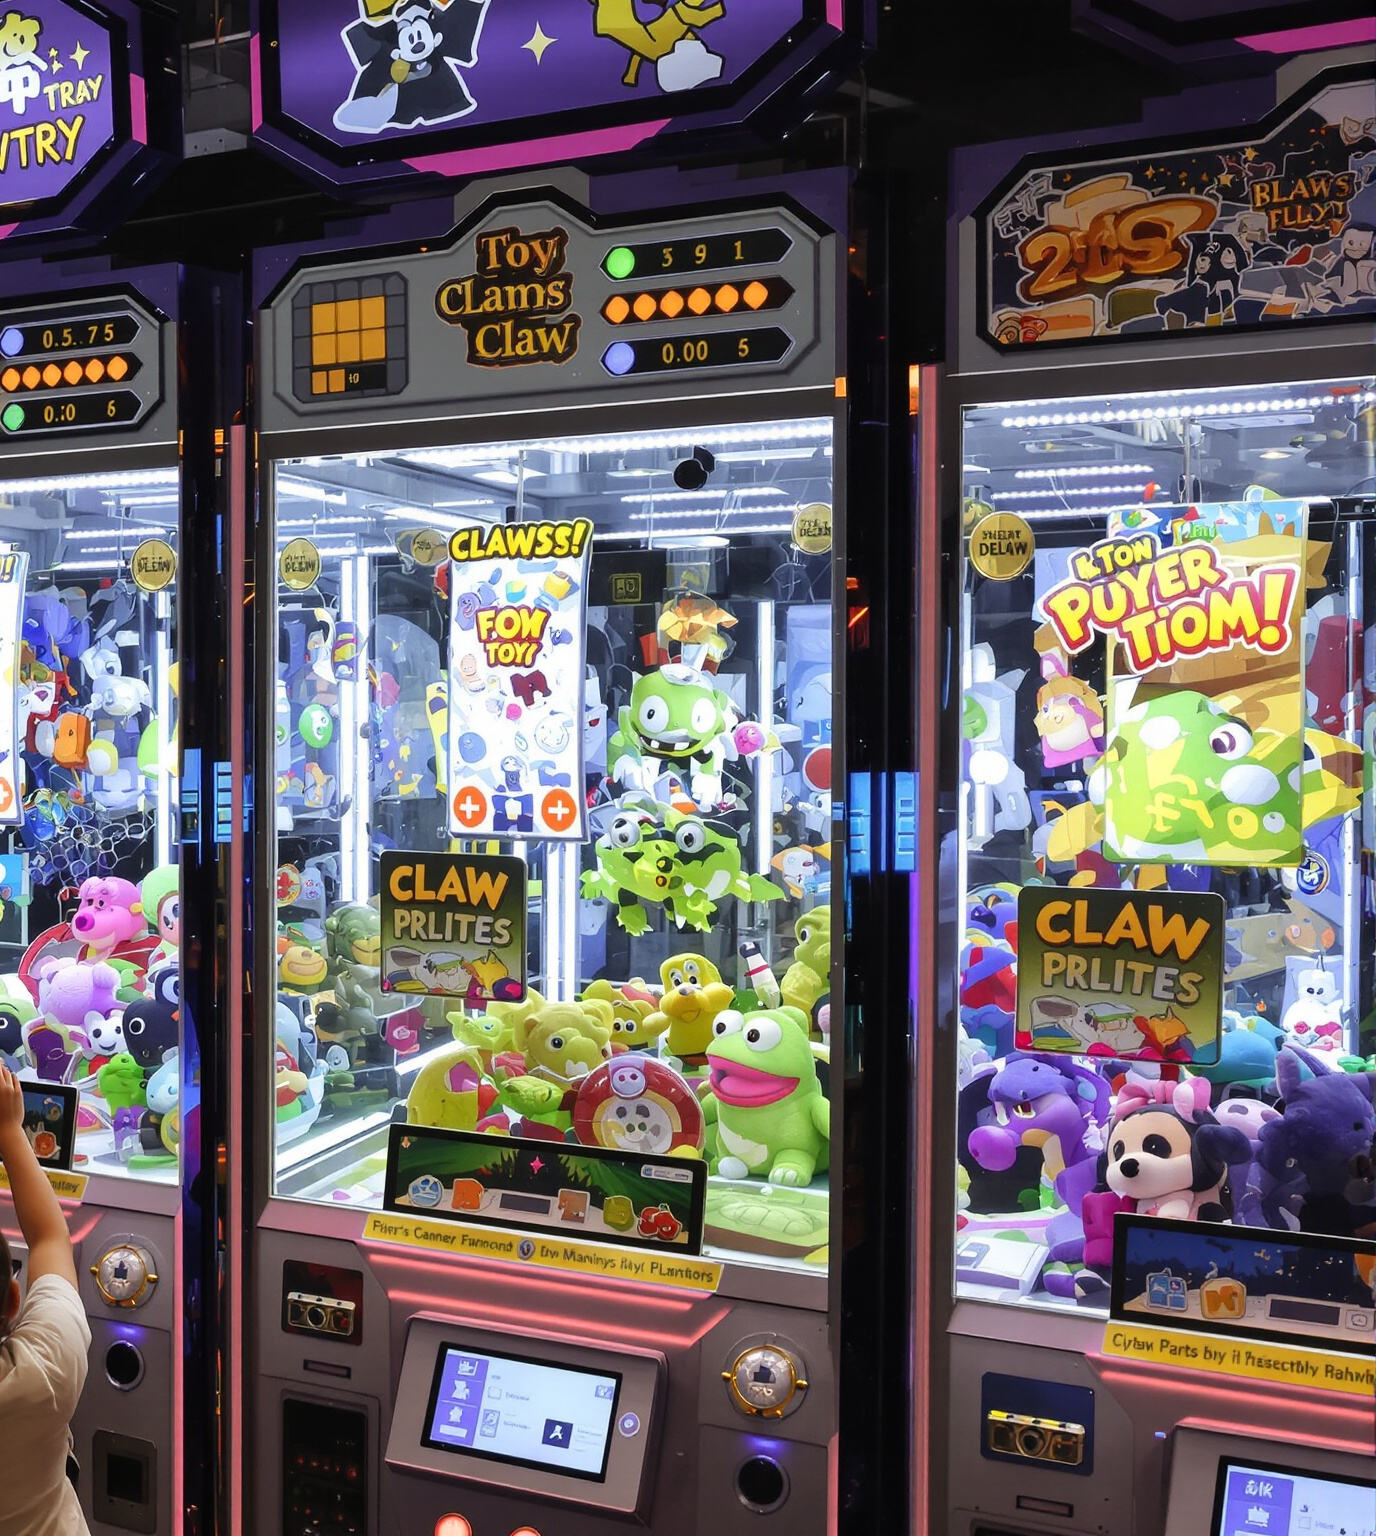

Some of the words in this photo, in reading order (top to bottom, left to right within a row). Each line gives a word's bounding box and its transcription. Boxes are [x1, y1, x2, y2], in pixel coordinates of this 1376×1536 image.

[43, 74, 103, 111] TRAY
[1252, 175, 1351, 207] BLAWS
[481, 233, 561, 276] Toy
[695, 243, 707, 265] 9
[734, 240, 745, 261] 1
[475, 319, 575, 359] Claw
[661, 342, 709, 364] 0.00
[738, 337, 749, 358] 5
[106, 399, 116, 418] 6
[451, 521, 587, 560] CLAWSS!
[979, 541, 1028, 557] DELAW
[1048, 547, 1221, 642] PUYER
[389, 863, 509, 910] CLAW
[393, 908, 513, 944] PRLITES
[1035, 900, 1211, 960] CLAW
[1043, 952, 1205, 1004] PRLITES
